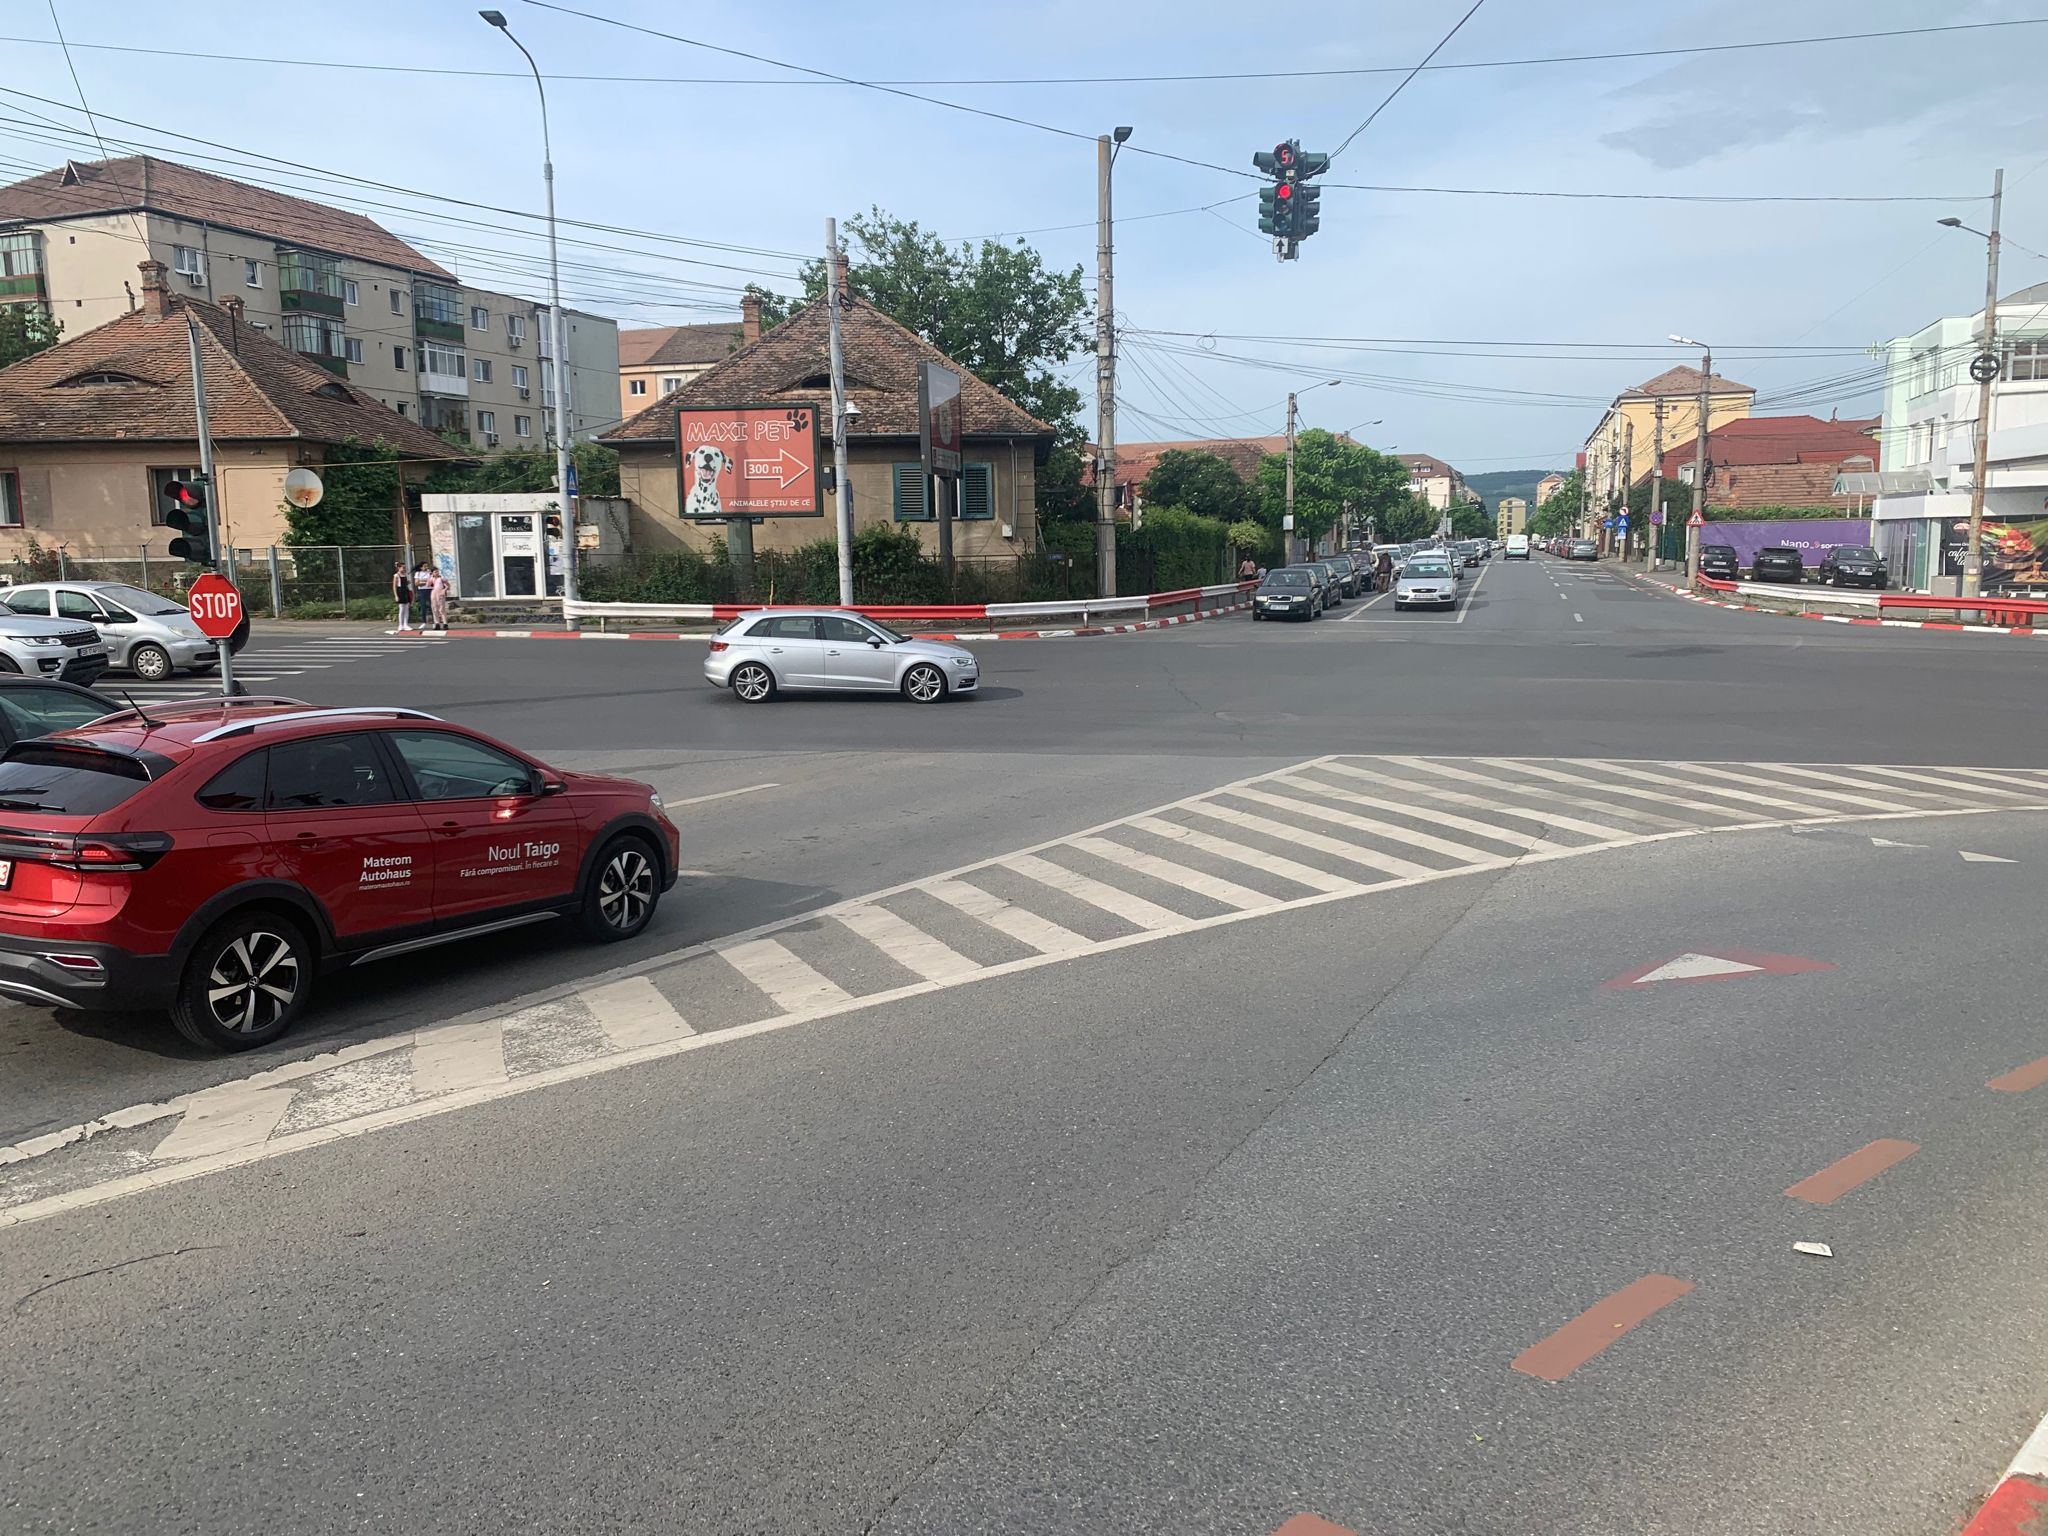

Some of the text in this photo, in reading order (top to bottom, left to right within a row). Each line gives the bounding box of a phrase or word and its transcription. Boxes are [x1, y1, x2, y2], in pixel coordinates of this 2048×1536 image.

[686, 420, 796, 442] MAXI PET
[748, 464, 783, 474] 300 m
[728, 500, 769, 508] ANIMALELE
[191, 592, 238, 619] STOP
[488, 841, 560, 862] Noul Taigo
[363, 856, 412, 869] Materom
[359, 868, 412, 882] Autohaus
